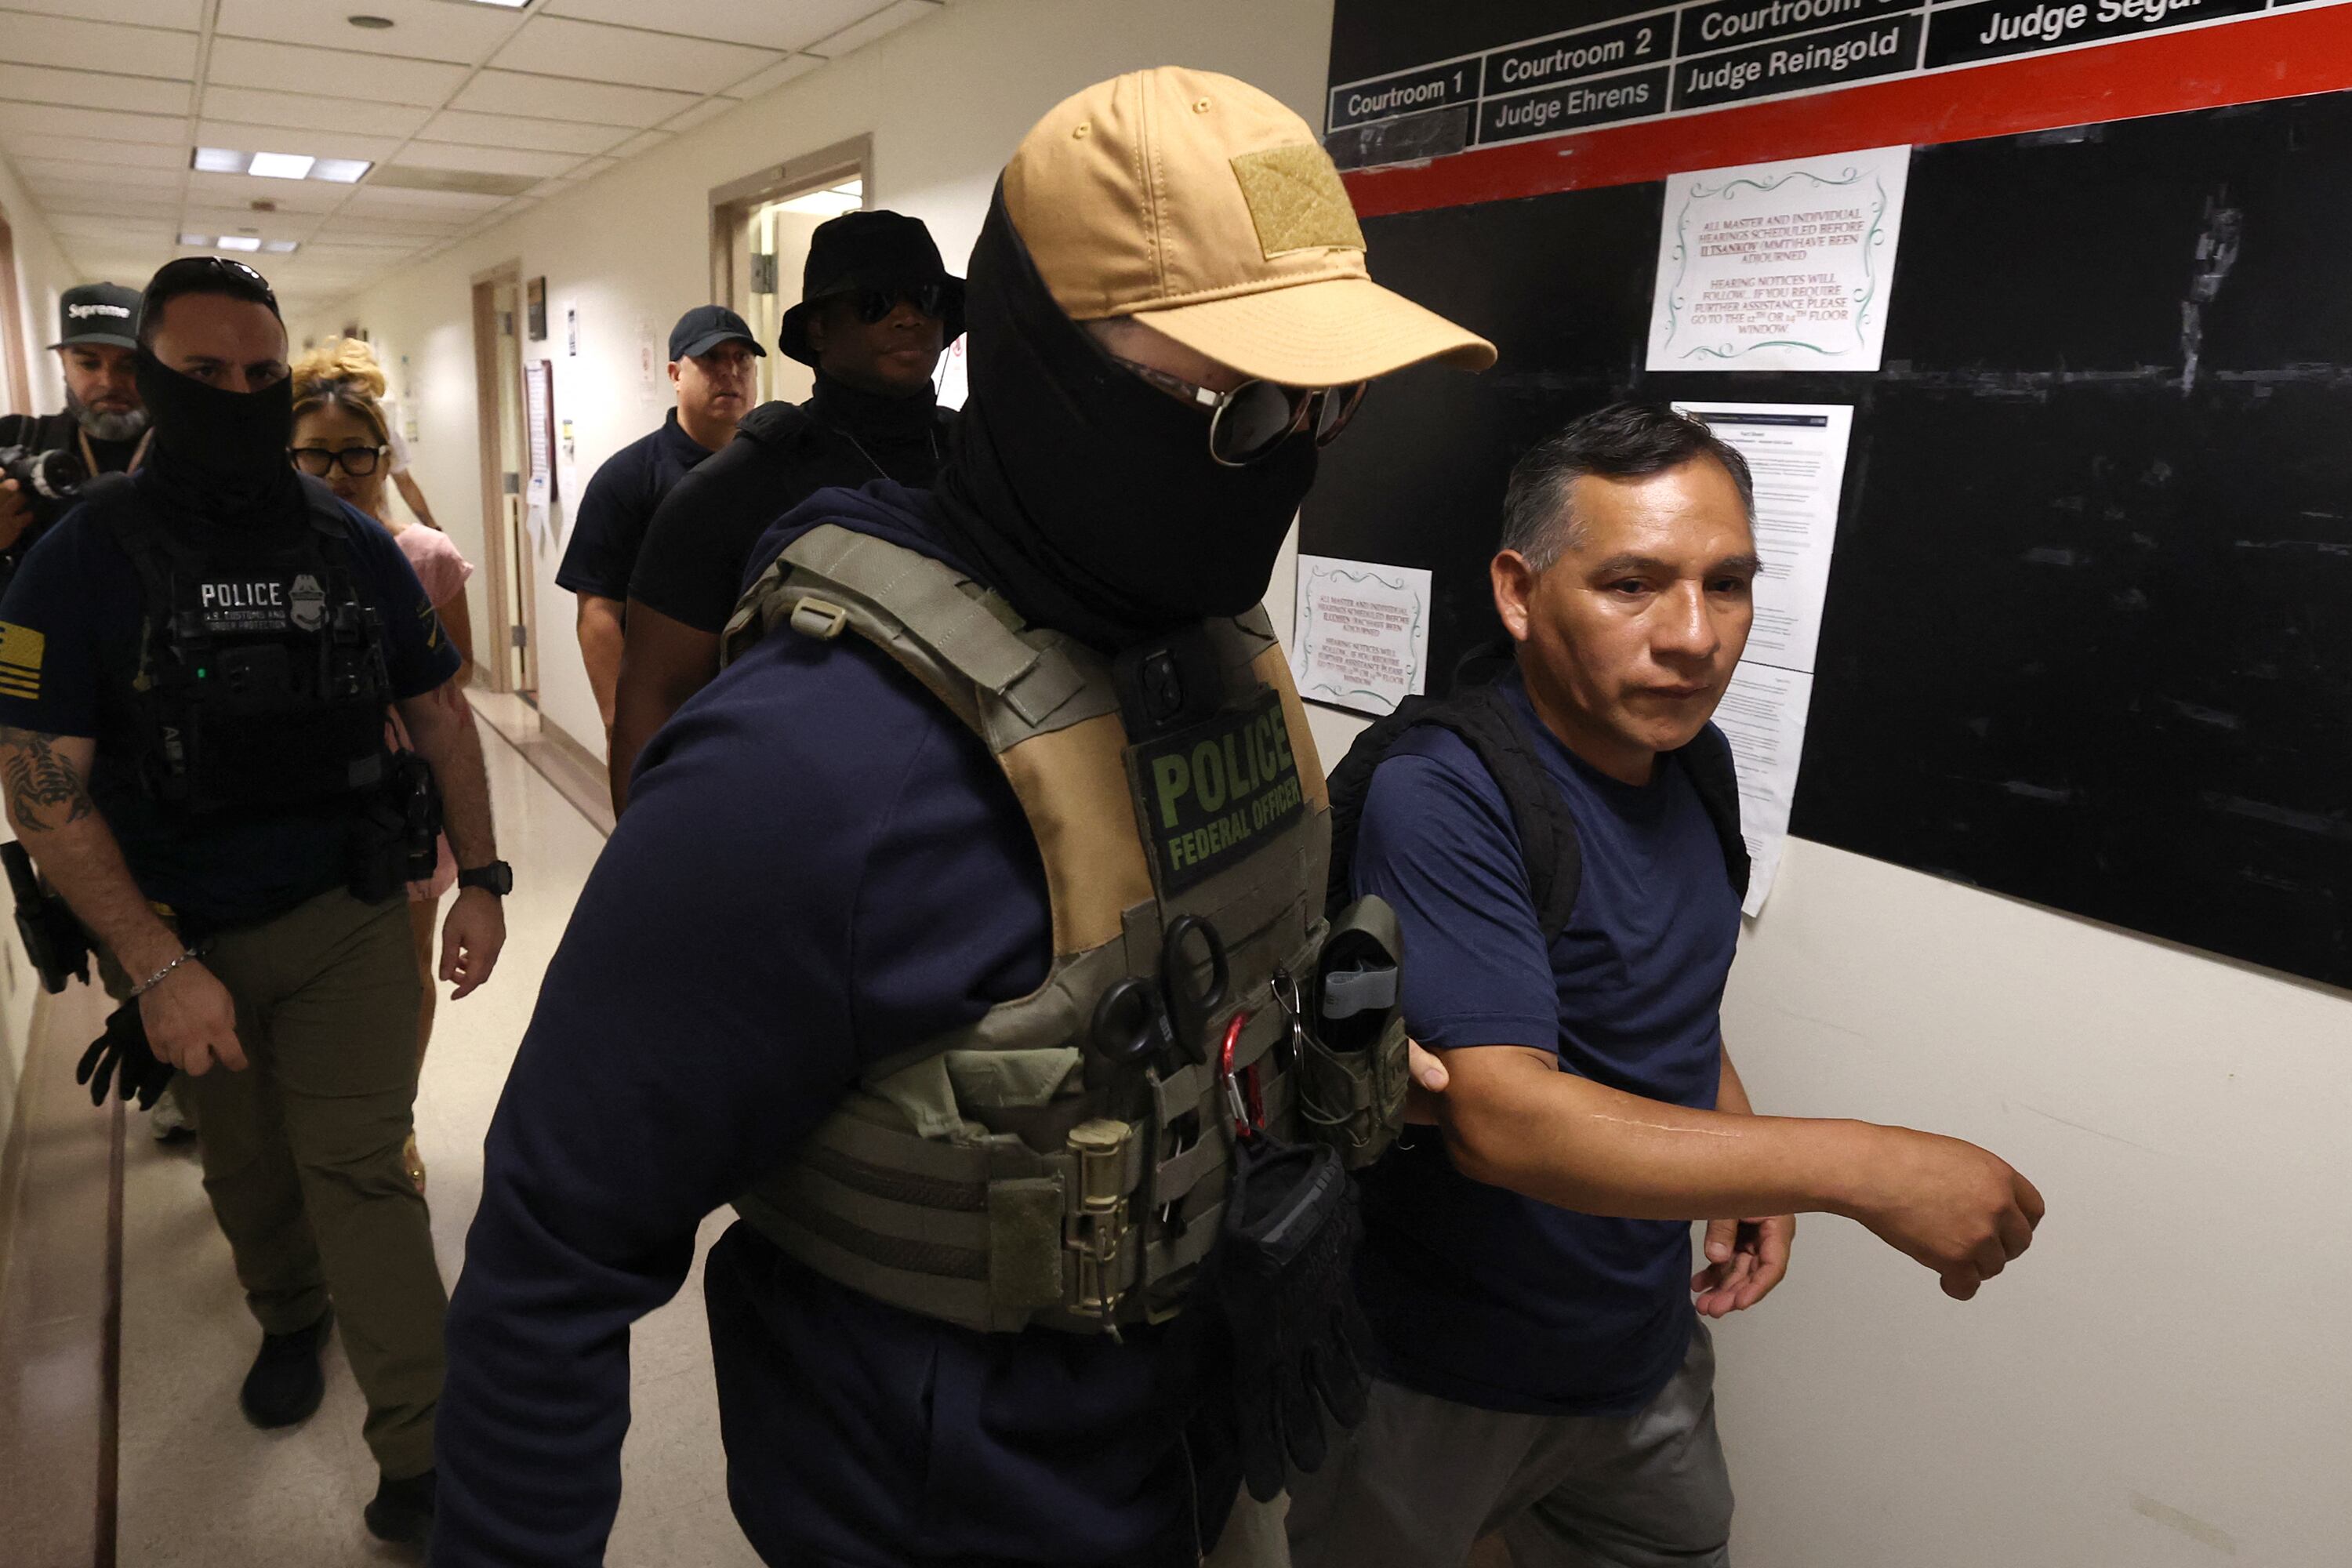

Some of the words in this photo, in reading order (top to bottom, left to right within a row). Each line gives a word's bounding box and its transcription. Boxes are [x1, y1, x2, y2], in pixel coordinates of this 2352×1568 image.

[1701, 0, 1861, 41] Courtroom
[1980, 1, 2089, 45] Judge
[2096, 0, 2202, 23] Seg
[1501, 39, 1625, 83] Courtroom
[1635, 28, 1653, 56] 2
[1686, 61, 1762, 93] Judge
[1768, 27, 1900, 76] Reingold
[1348, 79, 1445, 117] Courtroom
[1454, 71, 1464, 93] 1
[1495, 96, 1561, 129] Judge
[1568, 82, 1650, 114] Ehrens
[1723, 217, 1763, 229] MASTER
[1767, 215, 1791, 225] AND
[1792, 209, 1862, 223] INDIVIDUAL
[1751, 224, 1817, 238] SCHEDULED
[1820, 220, 1864, 233] BEFORE
[1797, 236, 1826, 247] HAVE
[1828, 234, 1859, 245] BEEN
[1710, 278, 1756, 289] HEARING
[1758, 274, 1806, 286] NOTICES
[1808, 273, 1836, 283] WILL
[1753, 289, 1765, 299] IF
[1766, 287, 1790, 298] YOU
[1791, 285, 1842, 297] REQUIRE
[68, 303, 130, 319] Supreme
[1691, 315, 1707, 325] GO
[1708, 314, 1722, 324] TO
[1726, 313, 1745, 323] THE
[1767, 312, 1784, 322] OR
[1809, 310, 1849, 321] FLOOR
[1694, 302, 1740, 313] FURTHER
[1742, 299, 1805, 311] ASSISTANCE
[1807, 297, 1849, 309] PLEASE
[201, 583, 283, 608] POLICE
[1152, 706, 1294, 829] POLICE
[1167, 808, 1252, 871] FEDERAL
[1252, 775, 1301, 831] OFFICER
